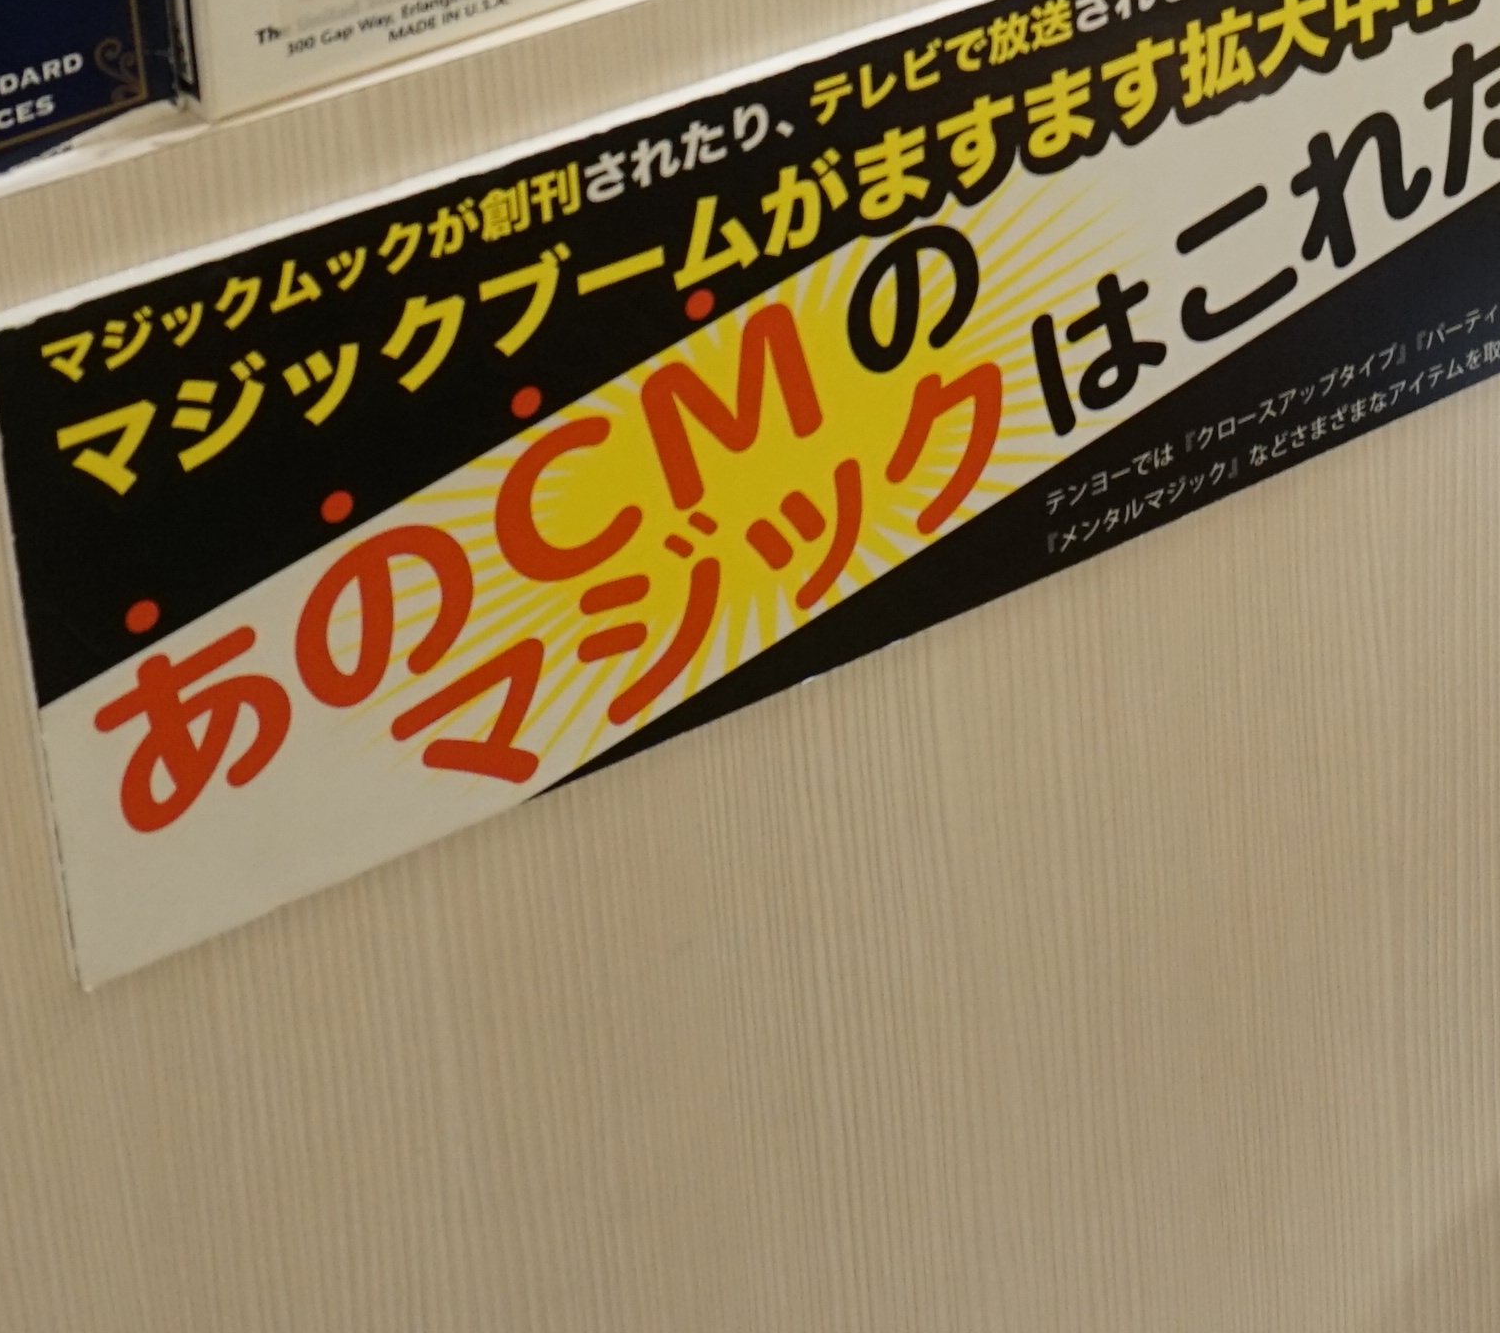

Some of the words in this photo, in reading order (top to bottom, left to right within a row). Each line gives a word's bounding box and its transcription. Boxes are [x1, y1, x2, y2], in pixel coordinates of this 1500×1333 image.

[319, 21, 353, 49] Gap
[387, 16, 439, 44] MADE
[95, 220, 982, 834] あのCMの
